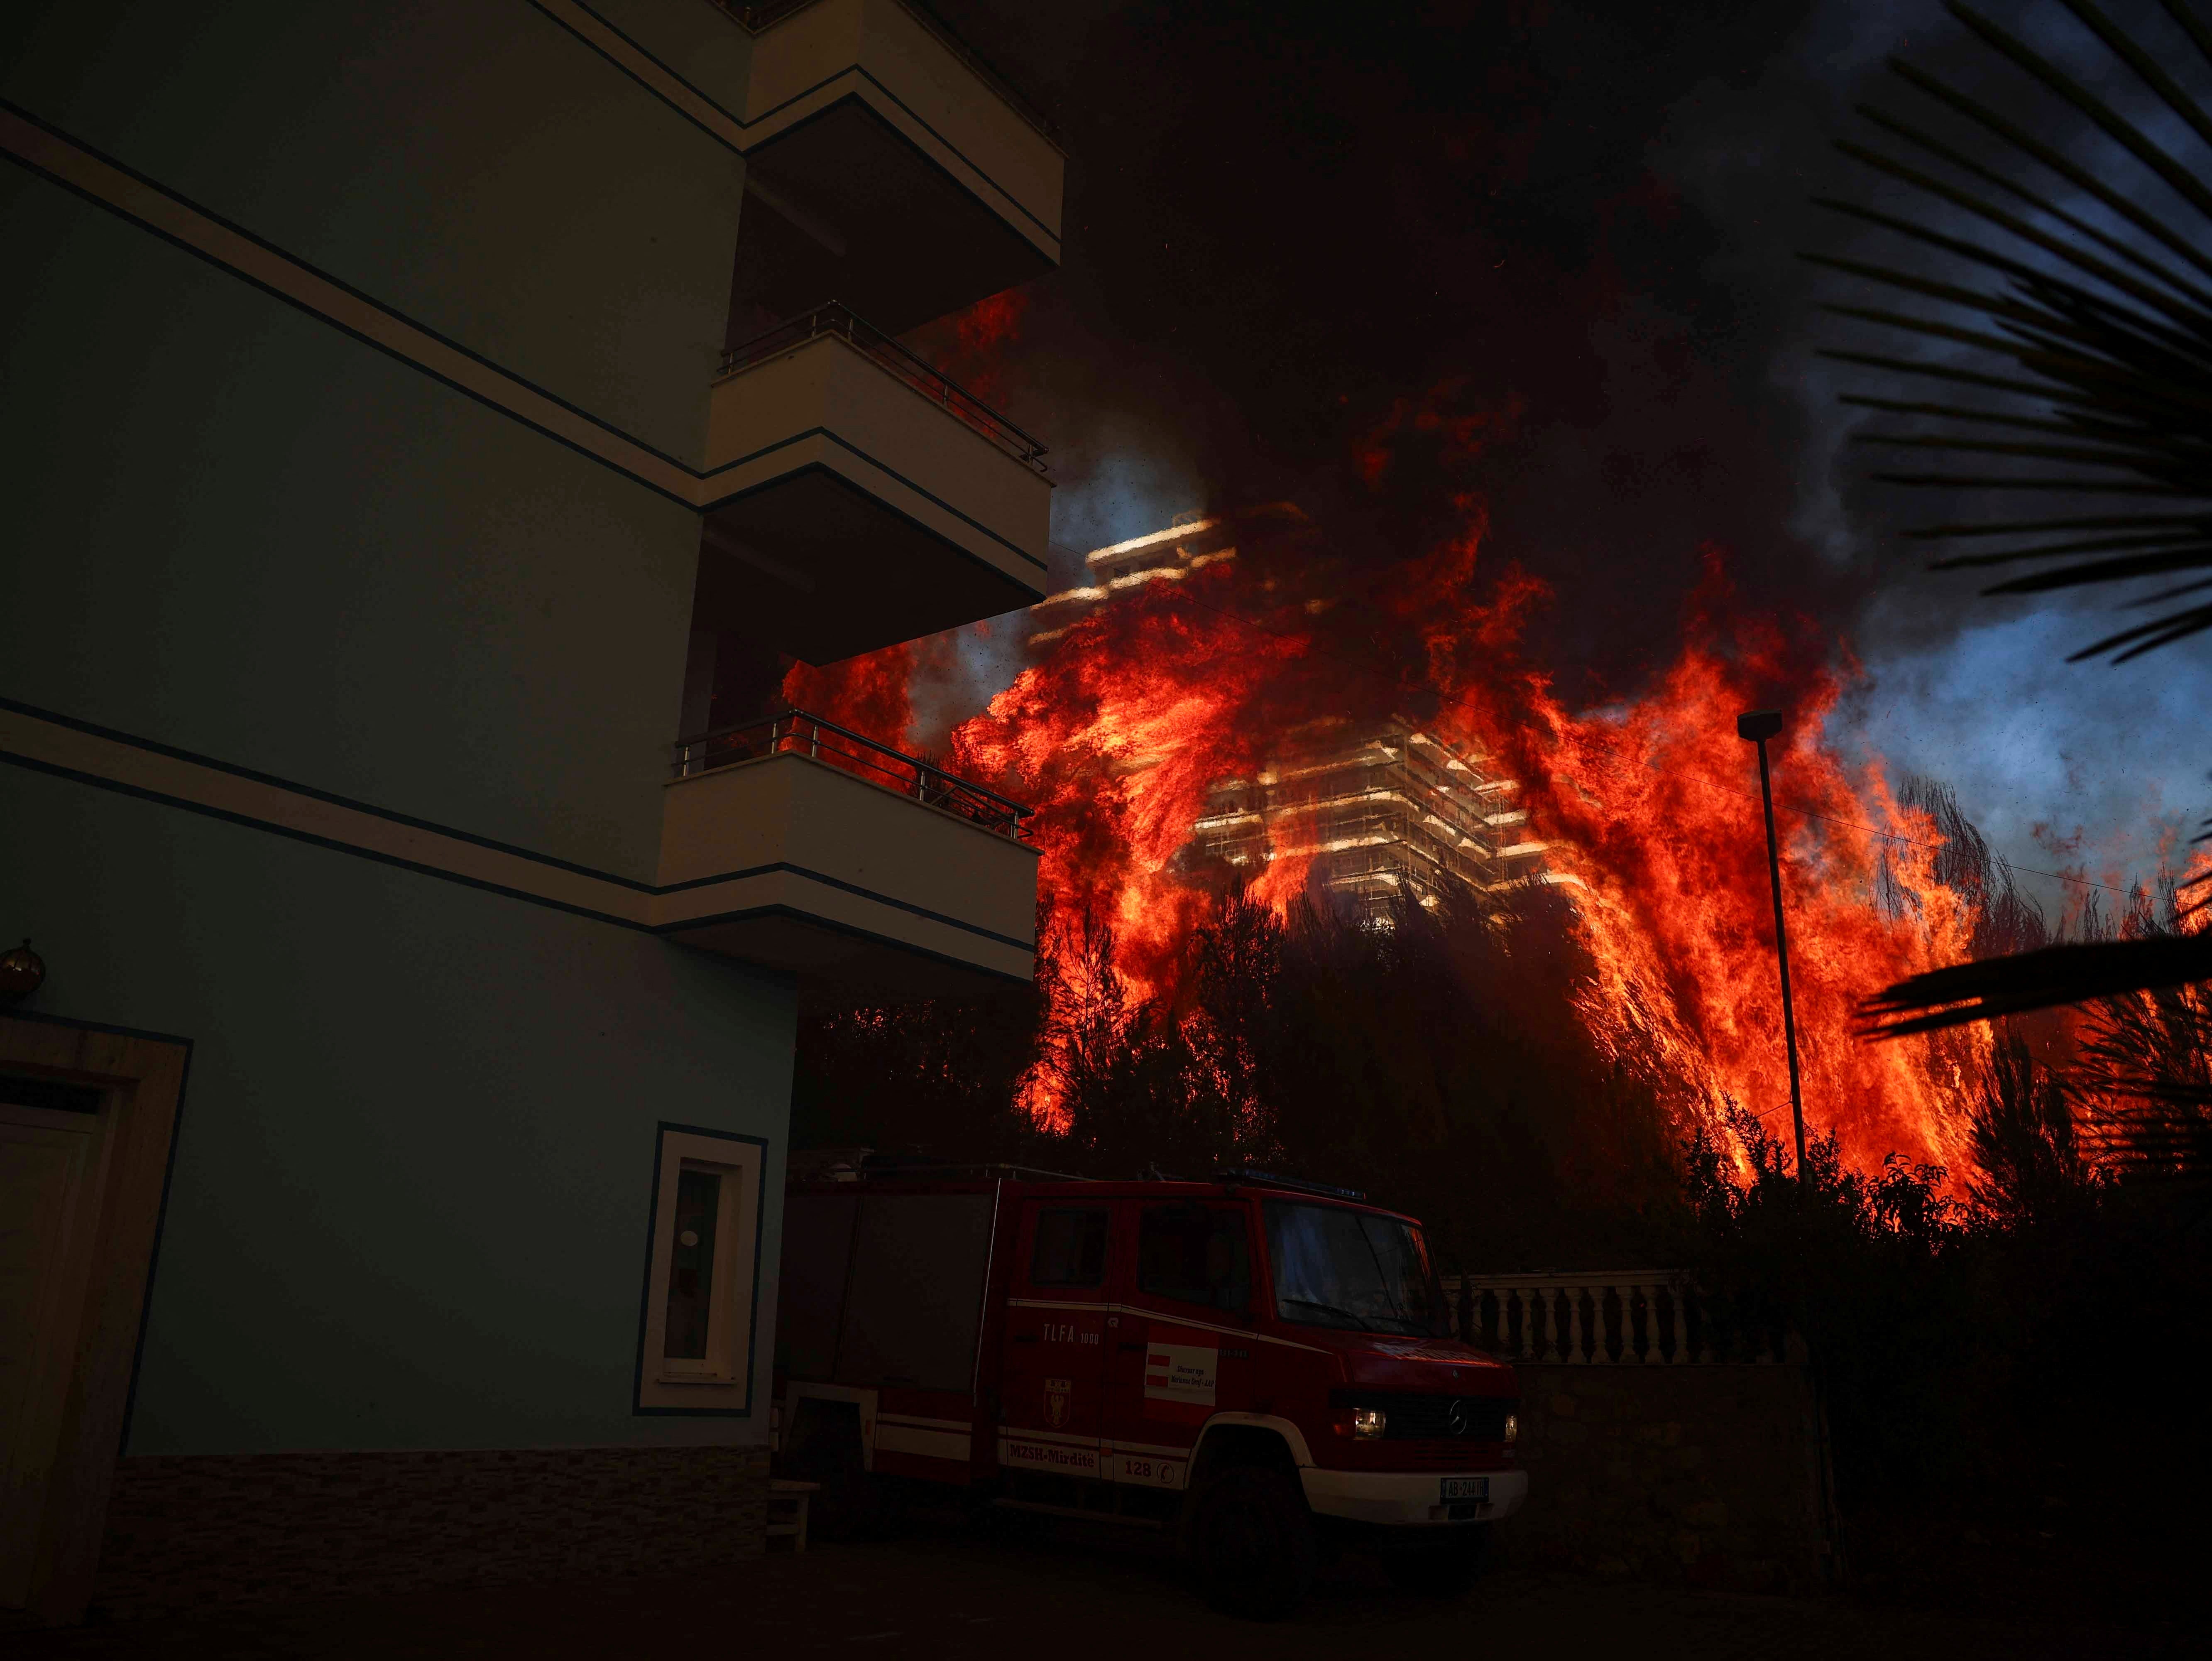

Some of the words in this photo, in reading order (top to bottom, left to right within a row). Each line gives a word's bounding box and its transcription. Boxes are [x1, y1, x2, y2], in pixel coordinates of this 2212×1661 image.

[1044, 1323, 1074, 1343] TLFA
[1080, 1332, 1099, 1345] 1000
[1010, 1443, 1094, 1468] MZSH-Mirditë
[1126, 1460, 1151, 1477] 128
